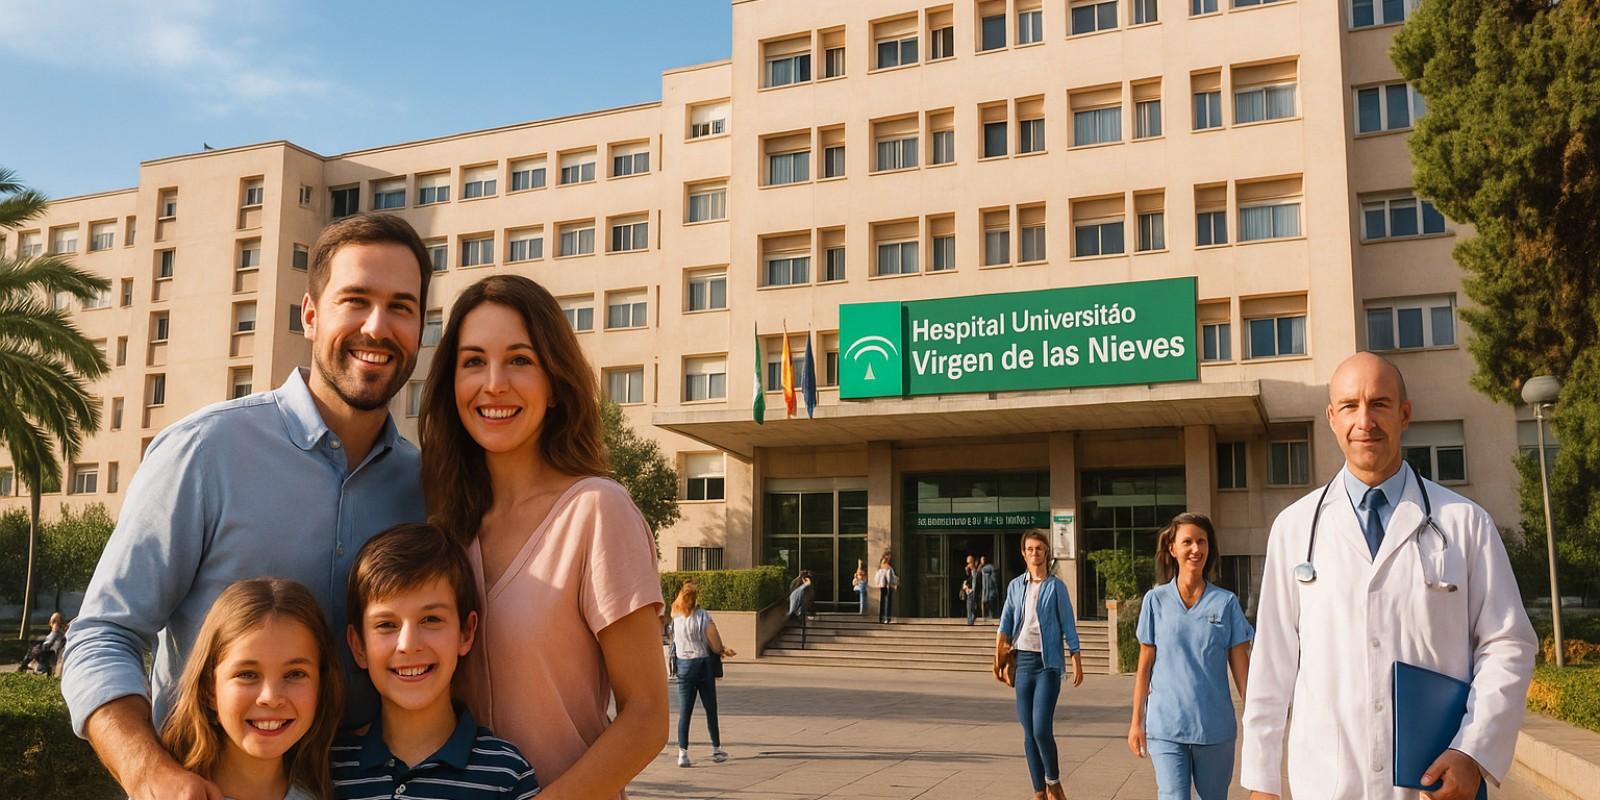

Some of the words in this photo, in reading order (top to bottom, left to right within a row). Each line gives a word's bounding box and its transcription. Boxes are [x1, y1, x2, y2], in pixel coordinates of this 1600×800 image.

[911, 349, 995, 381] Virgen
[1001, 343, 1034, 371] de
[1042, 340, 1080, 368] las
[1088, 334, 1185, 364] Nieves
